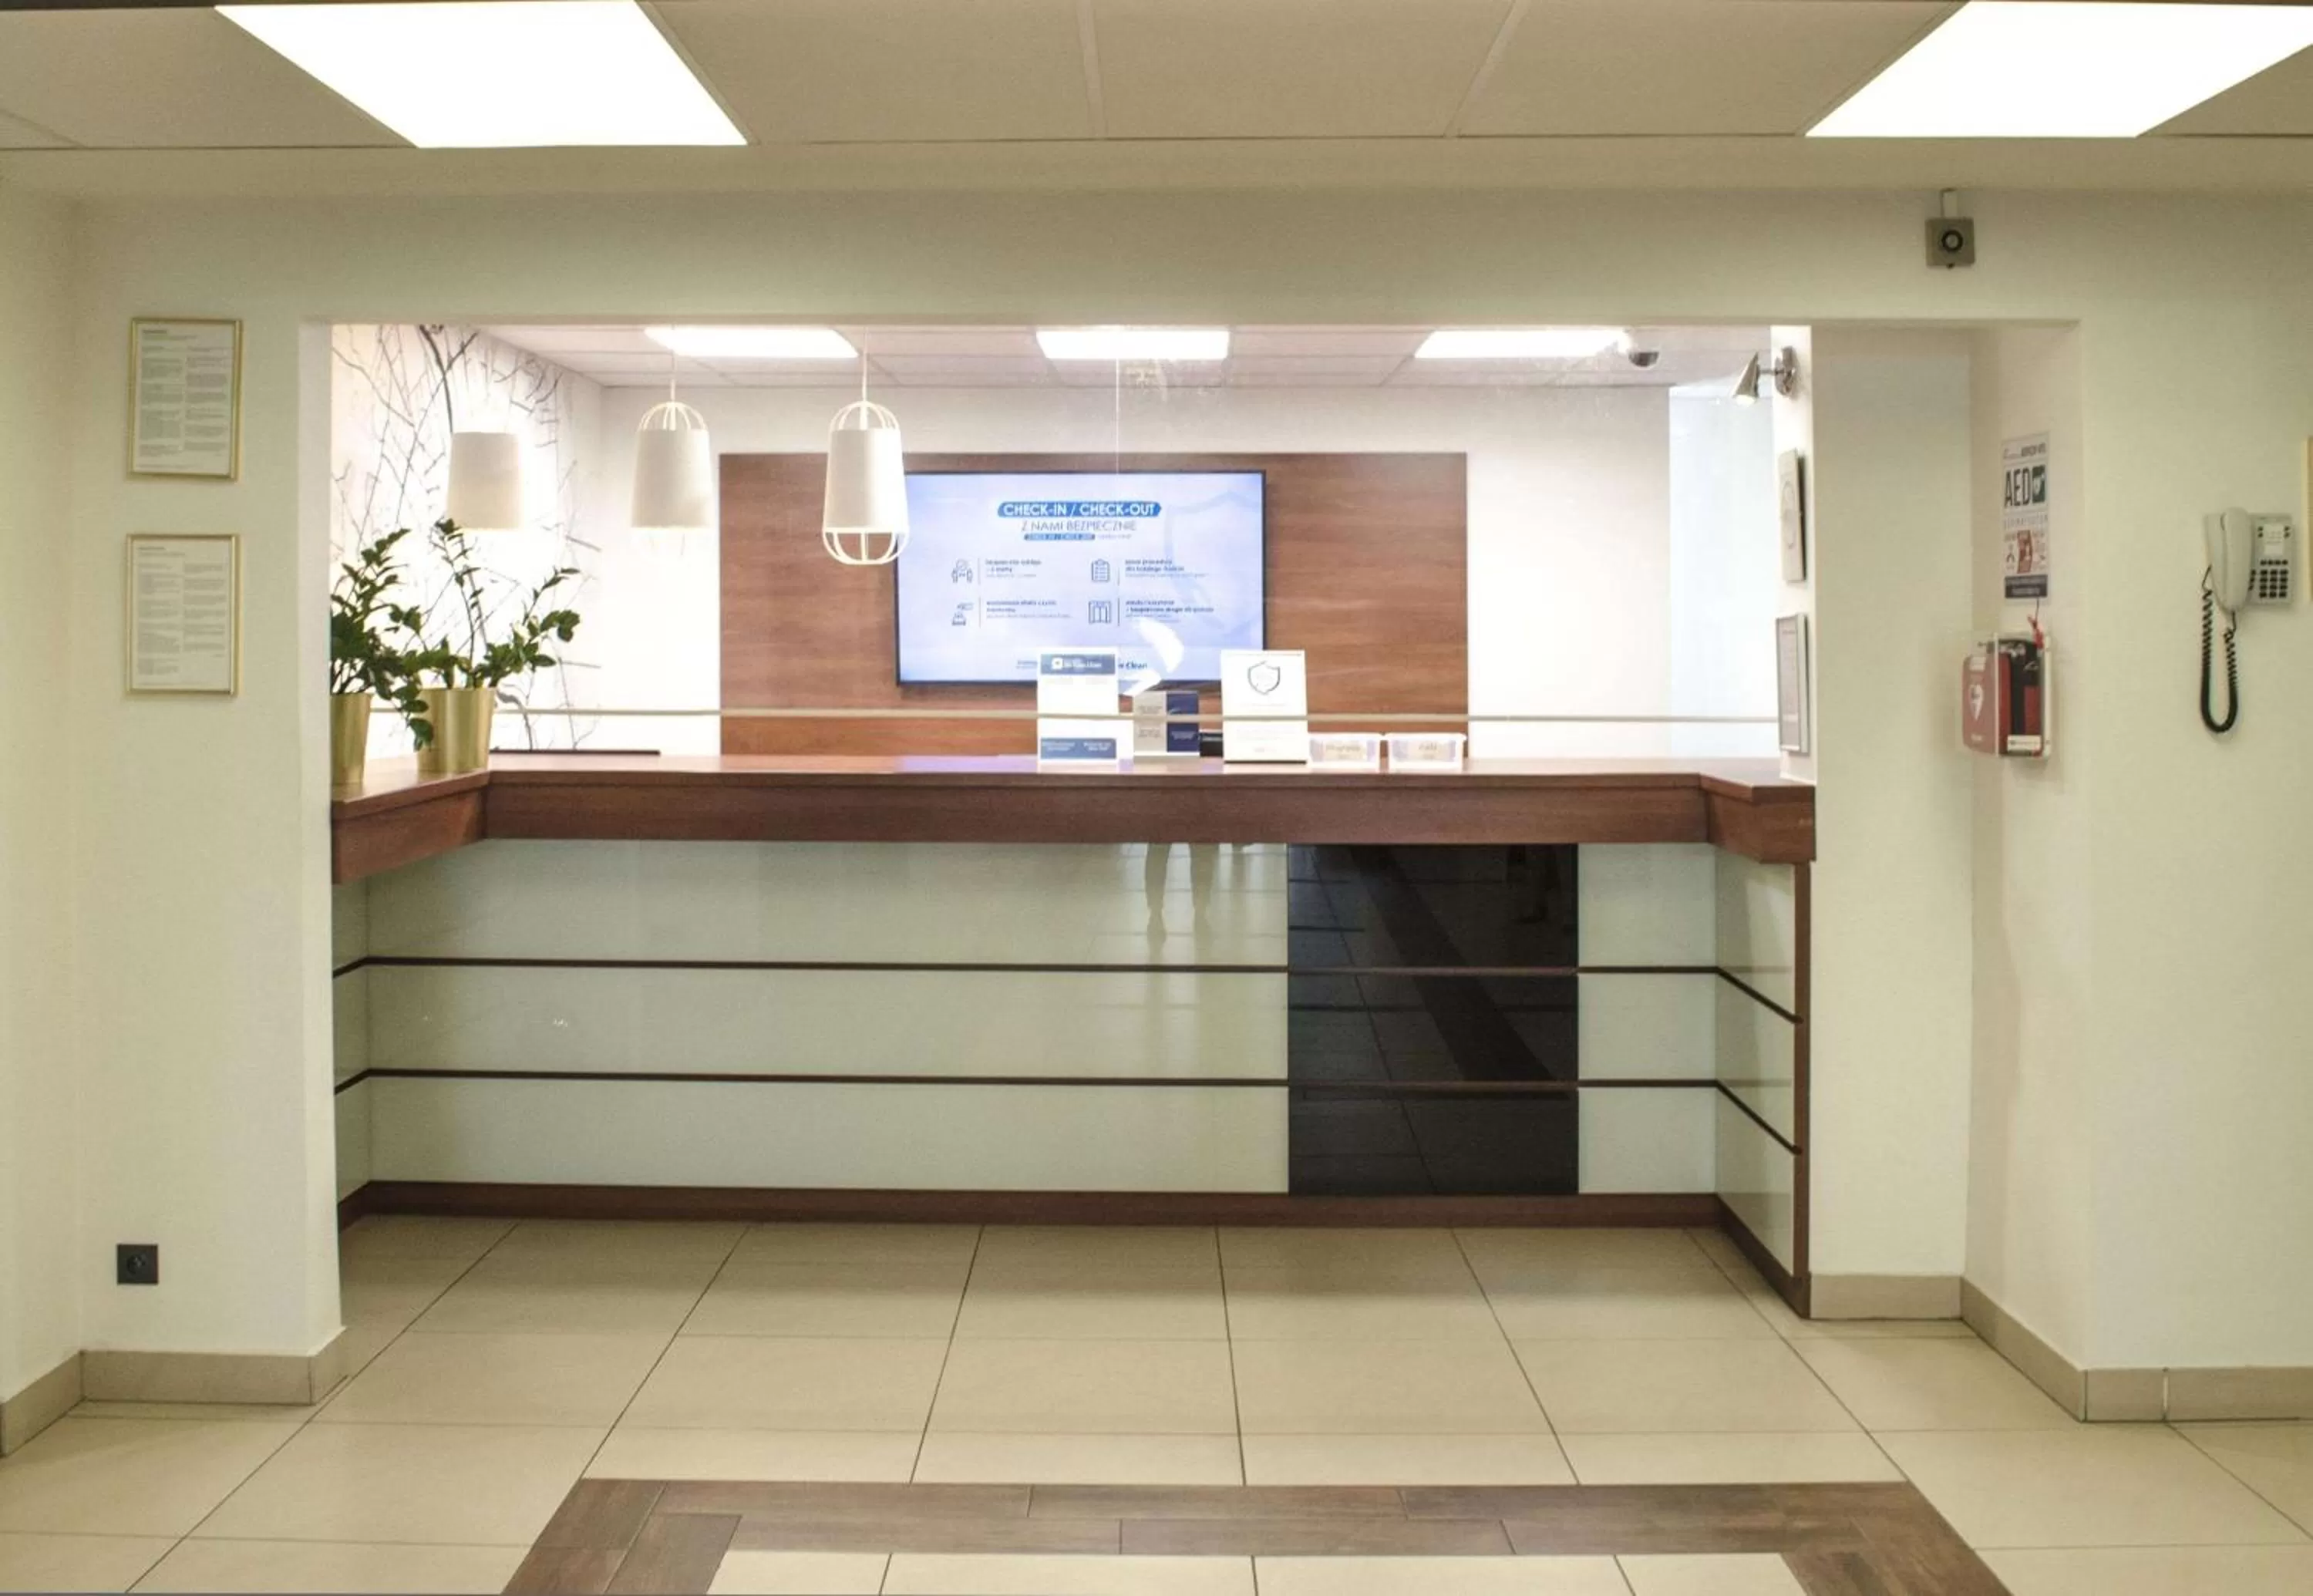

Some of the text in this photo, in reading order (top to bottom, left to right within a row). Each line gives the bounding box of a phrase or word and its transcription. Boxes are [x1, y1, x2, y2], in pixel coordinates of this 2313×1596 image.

[2004, 466, 2031, 508] AED
[1003, 503, 1066, 517] CHECK-IN
[1079, 503, 1155, 517] CHECK-OUT
[1021, 520, 1137, 531] Z NAMI BEZPIECZNIE
